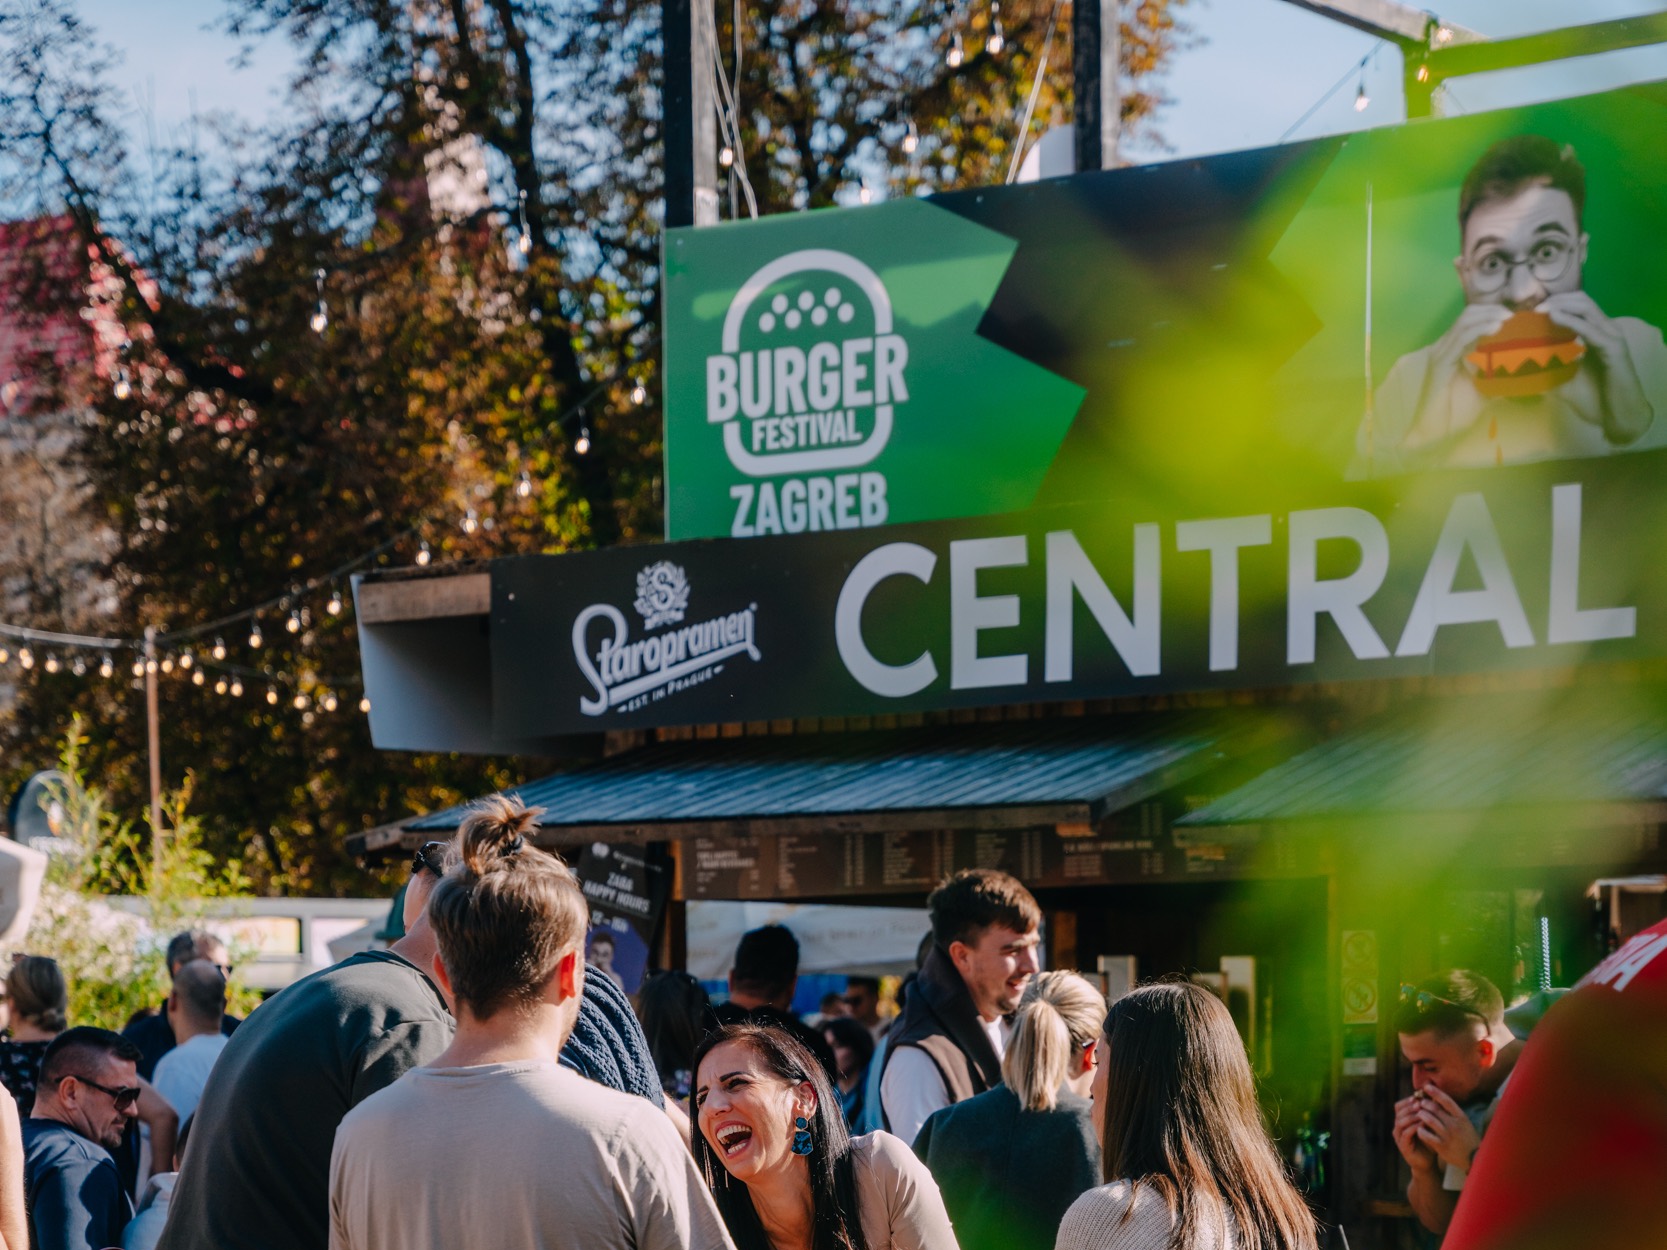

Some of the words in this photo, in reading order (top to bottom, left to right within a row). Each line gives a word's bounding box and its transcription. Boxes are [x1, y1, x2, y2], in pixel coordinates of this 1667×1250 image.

[706, 334, 910, 424] BURGER
[752, 408, 863, 452] FESTIVAL
[729, 471, 889, 538] ZAGREB
[834, 482, 1637, 698] CENTRAL
[572, 602, 761, 717] Staropramen
[583, 879, 616, 901] HAPPY
[616, 890, 650, 914] HOURS
